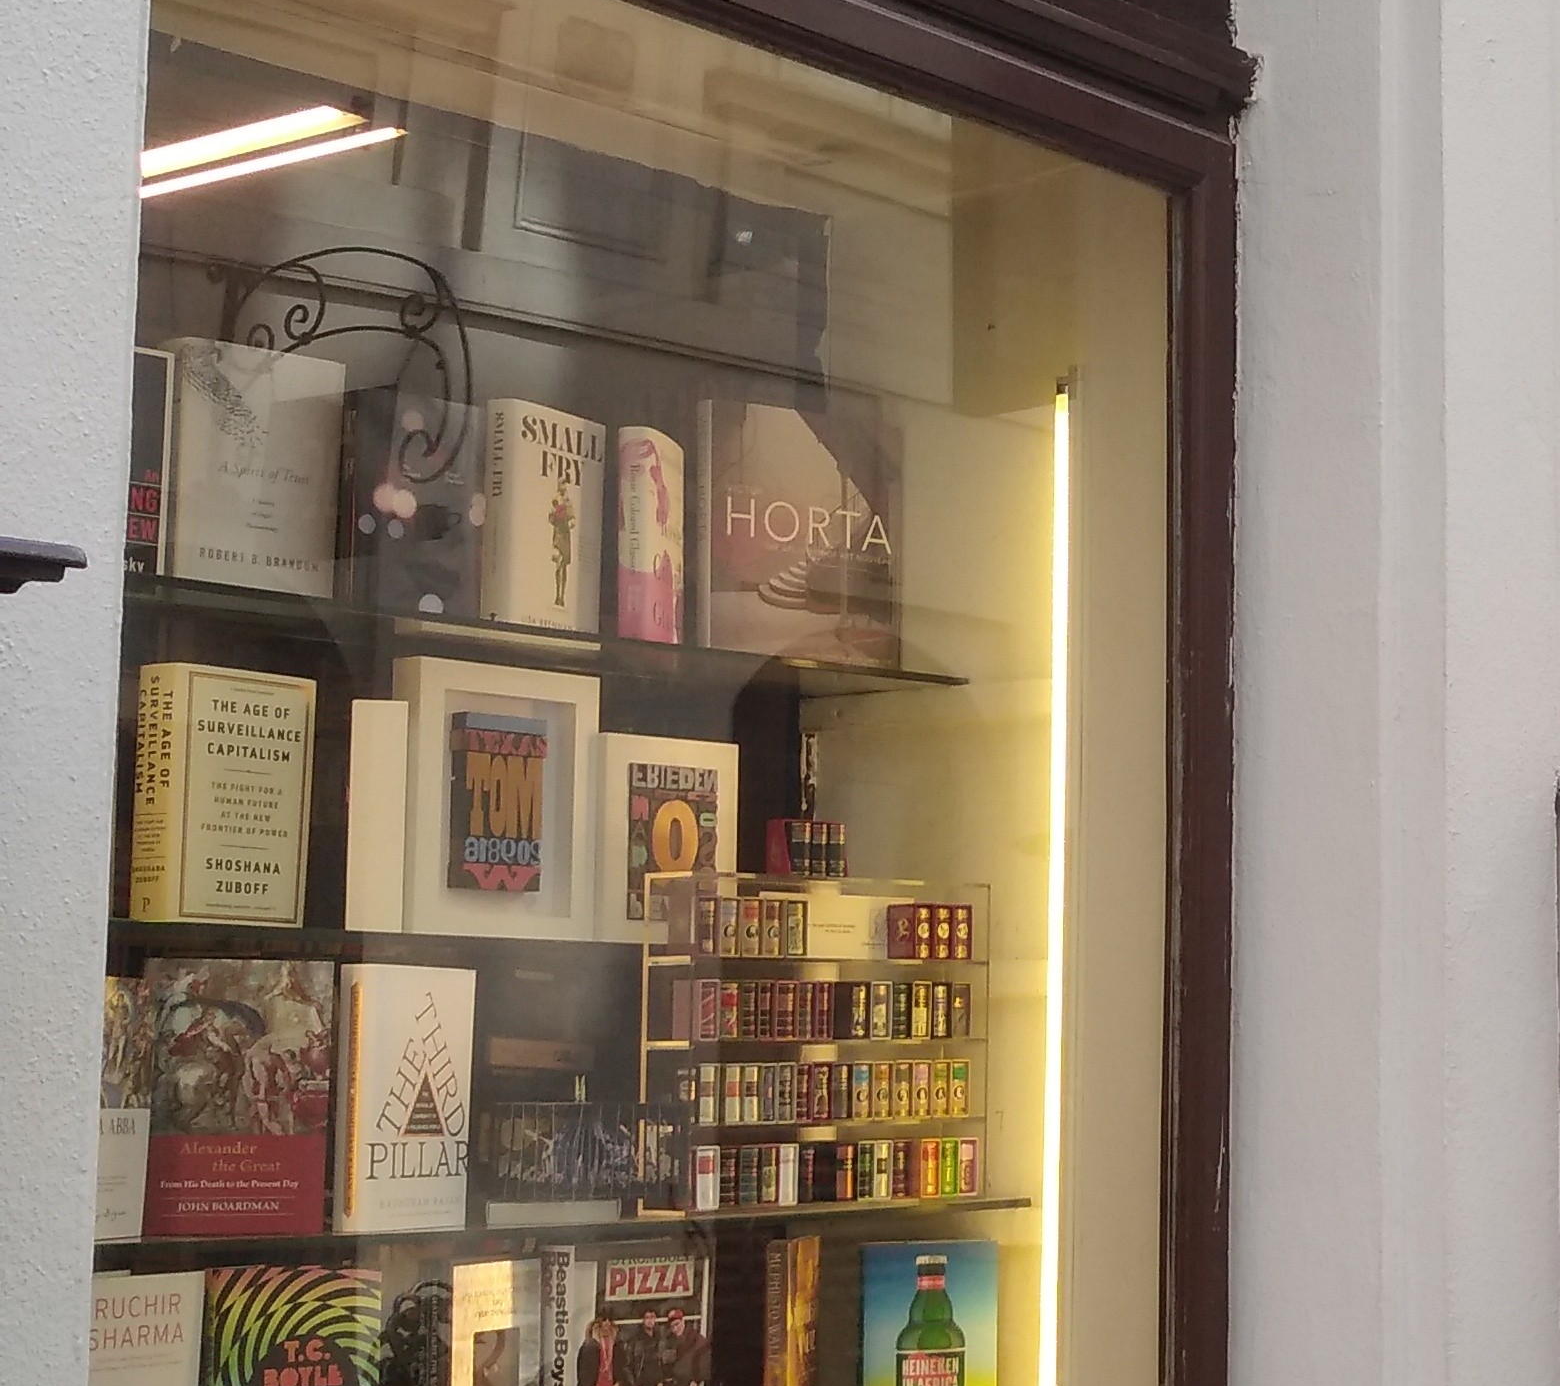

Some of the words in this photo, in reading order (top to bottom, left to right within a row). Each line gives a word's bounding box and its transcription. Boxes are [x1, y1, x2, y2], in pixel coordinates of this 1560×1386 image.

[521, 414, 603, 462] SMALL
[541, 450, 586, 486] FRY
[727, 496, 892, 554] HORTA
[199, 547, 244, 563] ROBERT
[162, 691, 174, 721] THE
[212, 699, 237, 713] THE
[243, 703, 269, 717] AGE
[274, 707, 291, 720] OF
[134, 690, 147, 794] CAPITALISM
[145, 675, 161, 806] SURVEILLANCE
[197, 719, 302, 743] SURVEILLANCE
[160, 729, 172, 760] AGE
[207, 742, 291, 763] CAPITALISM
[159, 770, 171, 789] OF
[211, 781, 227, 791] THE
[230, 783, 255, 794] FIGHT
[247, 798, 279, 810] FUTURE
[206, 857, 281, 875] SHOSHANA
[215, 880, 270, 895] ZUBOFF
[414, 991, 466, 1137] THIRD
[375, 1037, 427, 1137] THE
[180, 1141, 257, 1156] Alexander
[365, 1140, 469, 1181] PILLAR
[211, 1158, 236, 1173] the
[240, 1159, 282, 1173] Great
[160, 1179, 182, 1189] From
[199, 1179, 226, 1189] Death
[236, 1179, 249, 1189] the
[251, 1179, 280, 1189] Present
[282, 1179, 299, 1191] Day
[177, 1201, 209, 1213] JOHN
[212, 1200, 280, 1212] BOARDMAN
[608, 1264, 690, 1297] PIZZA
[95, 1293, 182, 1320] RUCHIR
[552, 1251, 571, 1339] Beastie
[89, 1322, 184, 1352] SHARMA
[284, 1338, 331, 1363] T.C.
[902, 1356, 960, 1377] HEINEKEN
